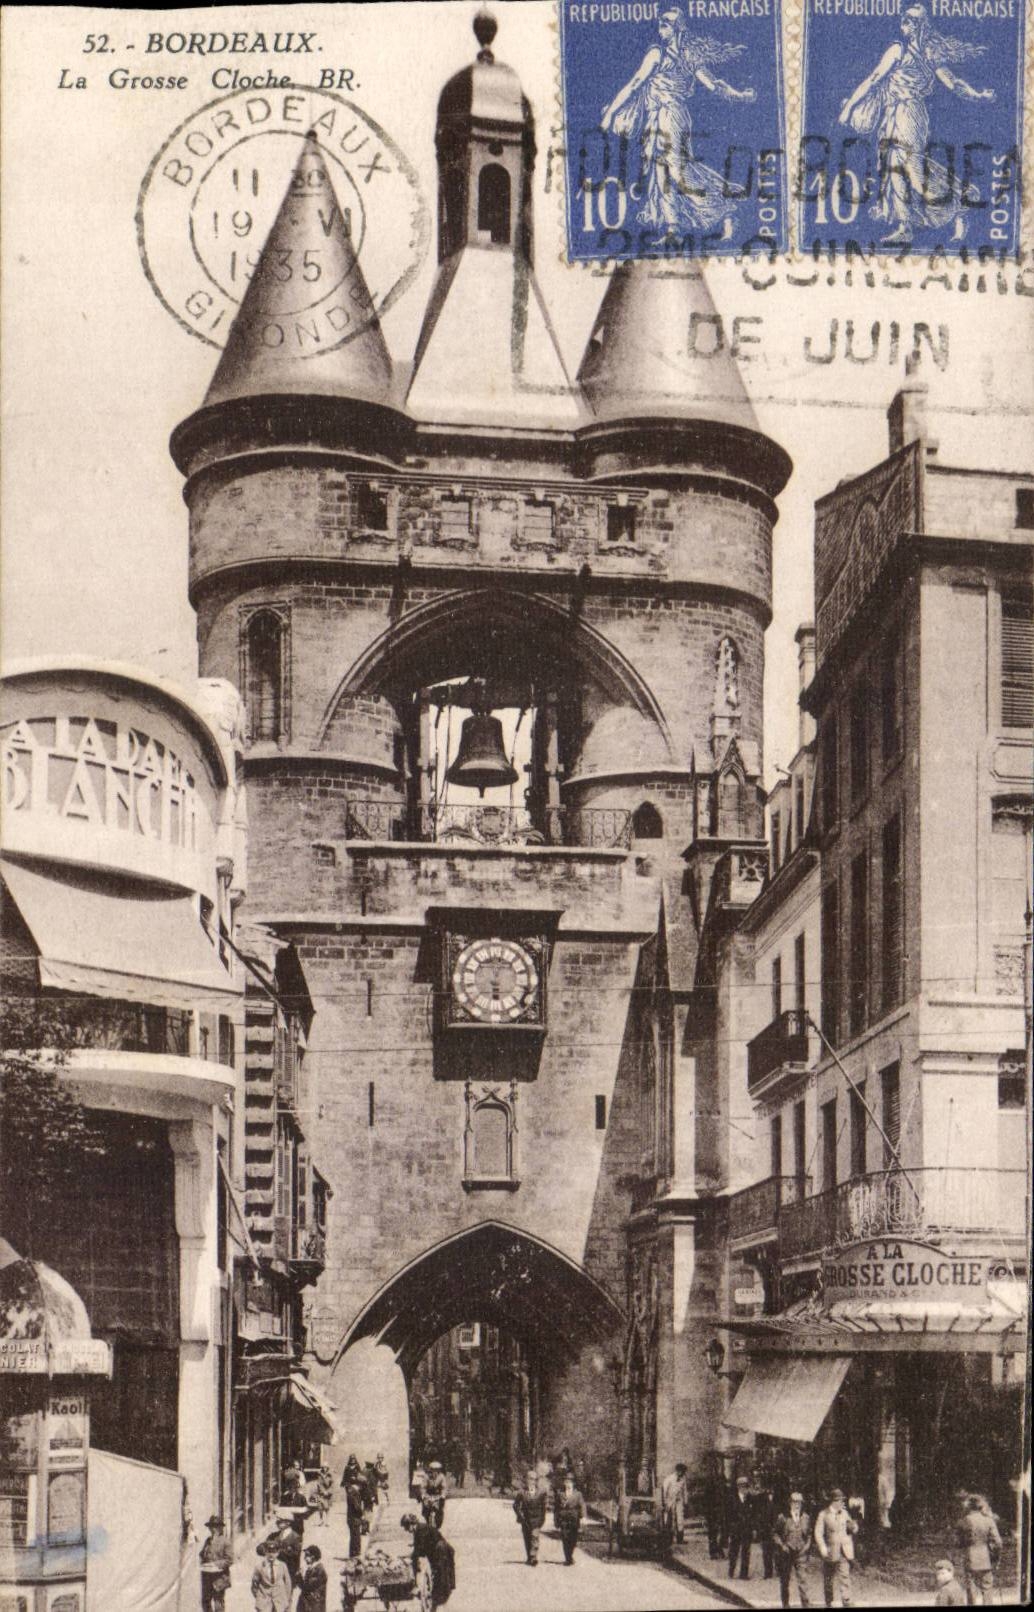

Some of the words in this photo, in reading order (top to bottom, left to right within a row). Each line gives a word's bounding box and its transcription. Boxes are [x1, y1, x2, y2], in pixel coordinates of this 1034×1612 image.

[162, 95, 392, 188] BORDEAUX
[687, 311, 763, 362] DE
[803, 318, 950, 373] JUIN
[867, 1244, 878, 1260] A
[883, 1243, 904, 1260] LA
[892, 1262, 982, 1287] CLOCHE
